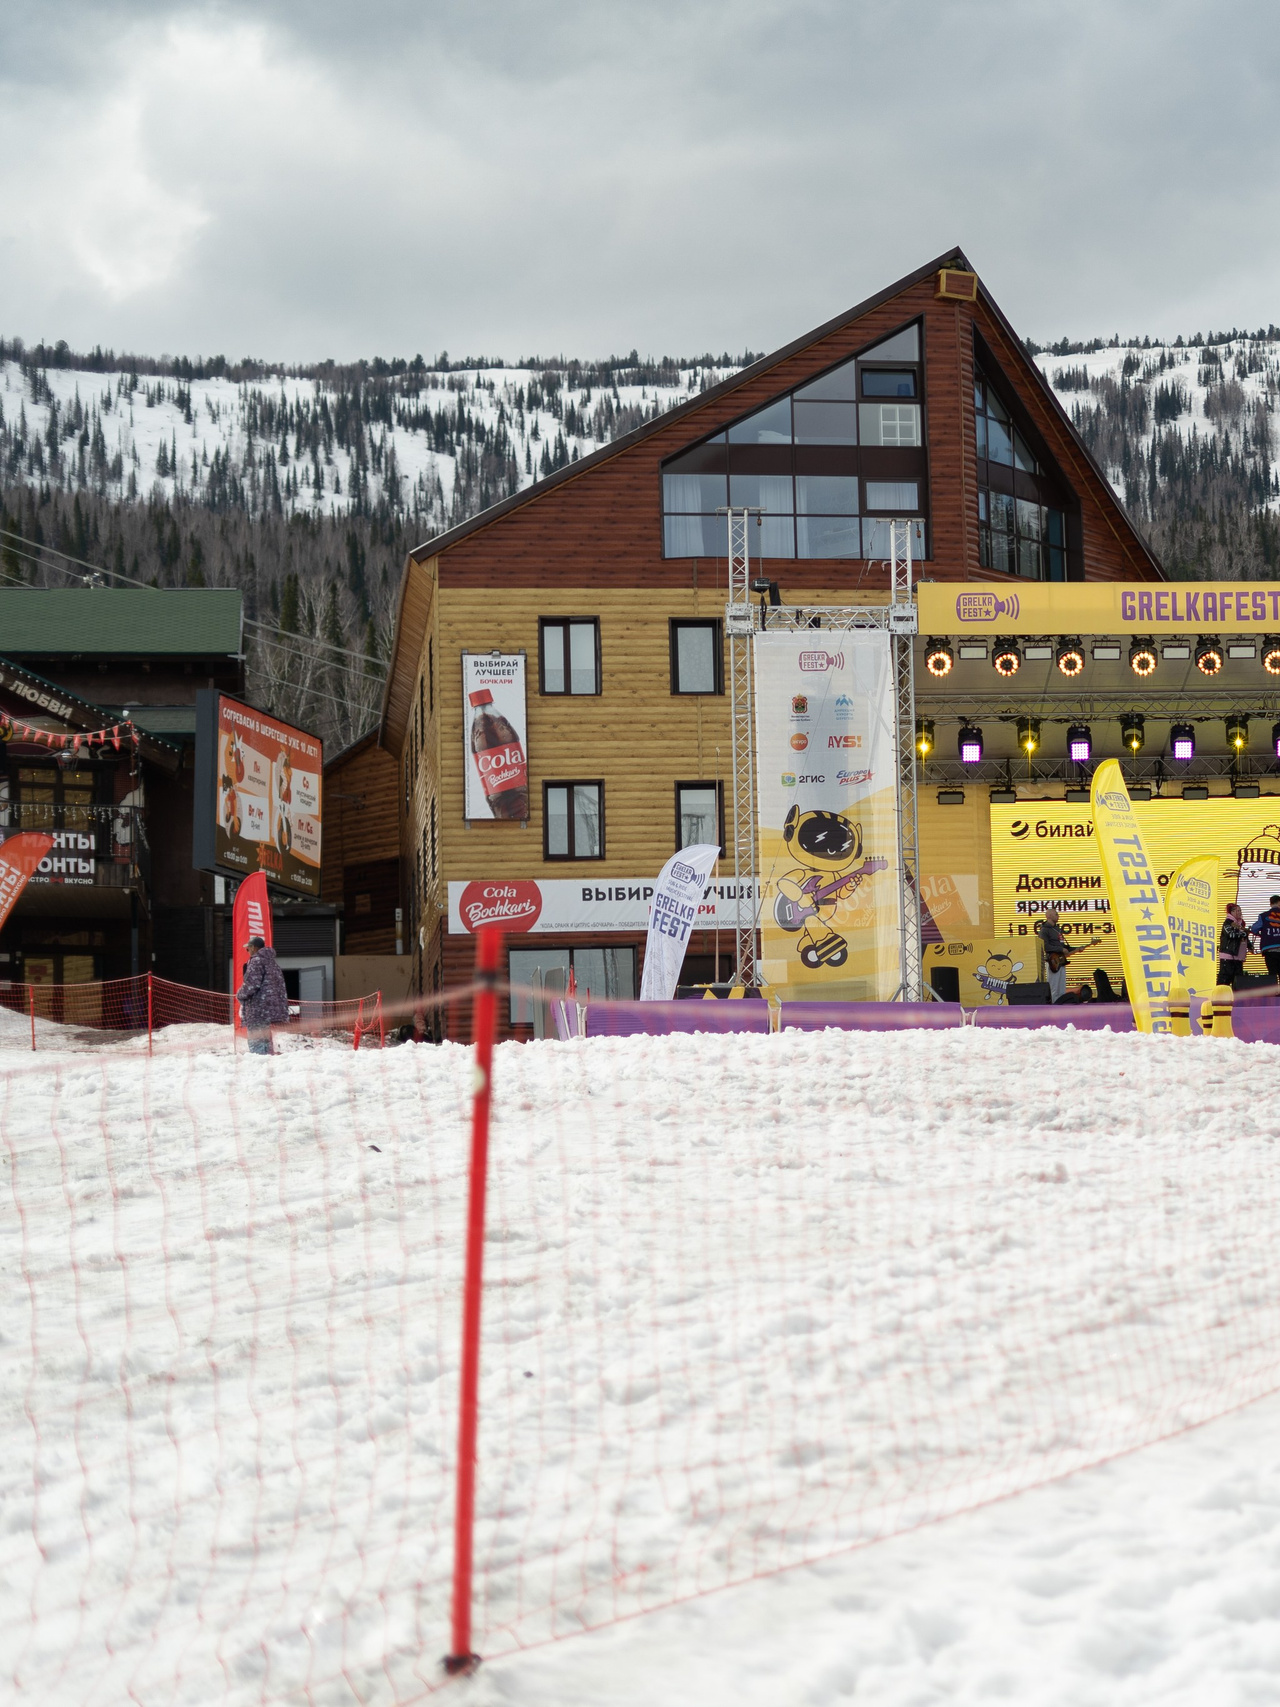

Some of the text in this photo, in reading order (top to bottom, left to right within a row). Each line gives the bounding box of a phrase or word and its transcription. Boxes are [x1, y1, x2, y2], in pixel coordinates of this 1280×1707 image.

[962, 597, 993, 607] GRELKA
[962, 608, 983, 617] FEST
[474, 659, 518, 667] ВЫБИРАЙ
[9, 680, 73, 719] ЛЮБВИ
[828, 735, 862, 748] AYS!
[478, 748, 522, 773] Cola
[799, 775, 826, 783] 2ГИС
[1035, 820, 1095, 838] билай
[920, 875, 952, 903] ola
[1015, 873, 1101, 892] Дополни
[483, 886, 517, 898] Cola
[582, 885, 654, 901] ВЫБИР
[465, 898, 536, 928] Bochkari
[656, 893, 695, 921] GRELKA
[1016, 899, 1088, 916] яркими
[653, 909, 691, 941] FEST
